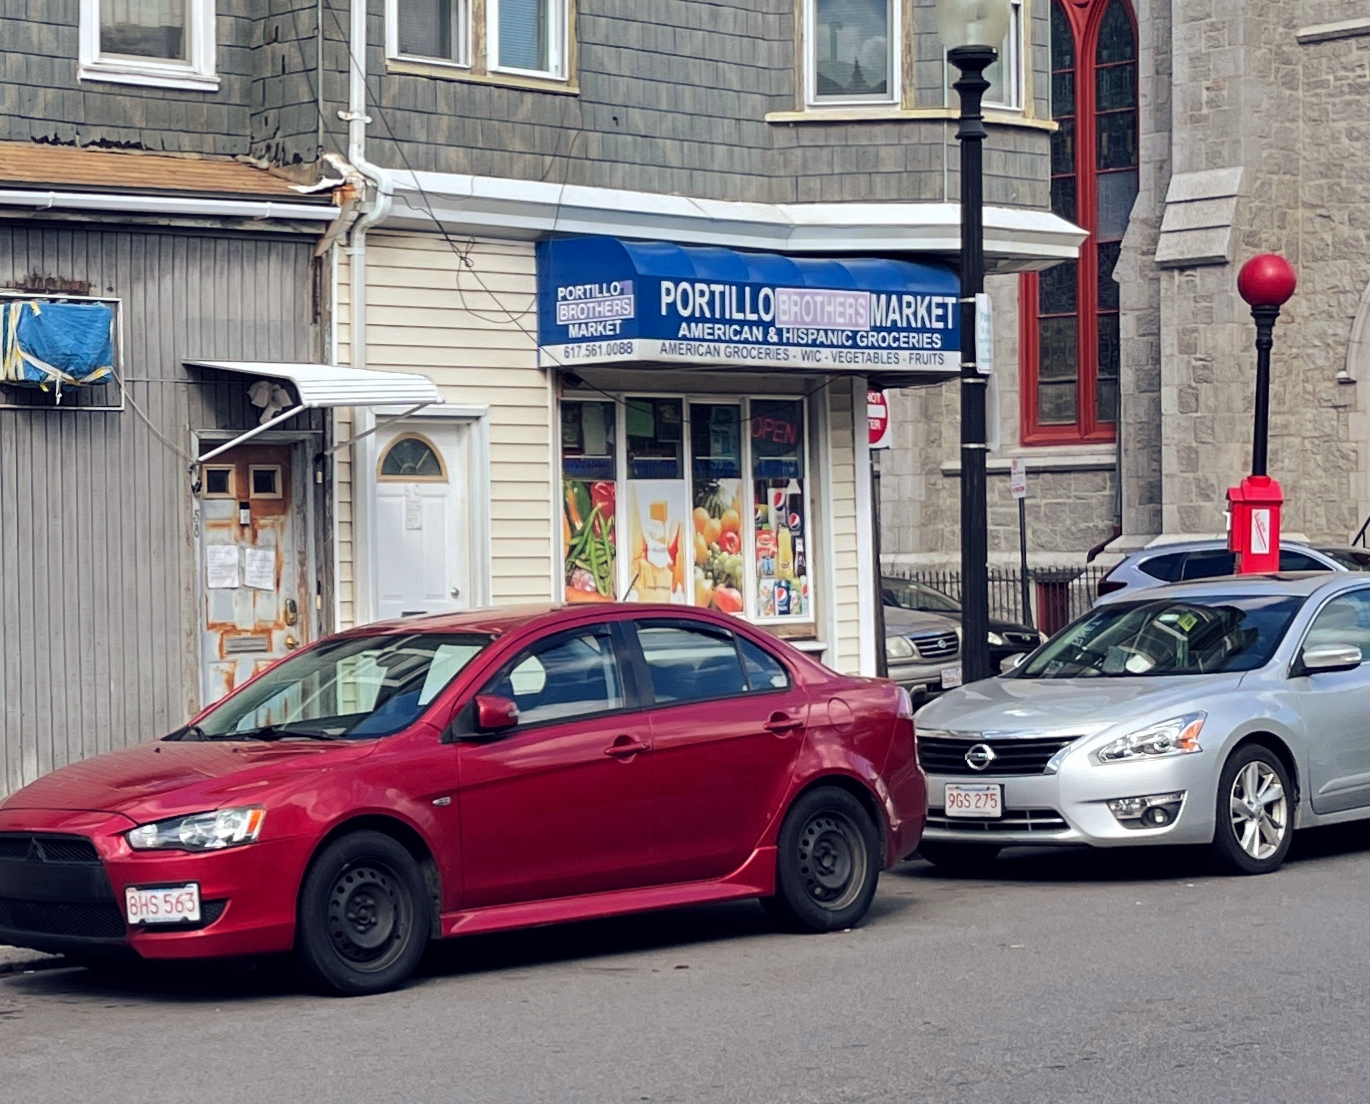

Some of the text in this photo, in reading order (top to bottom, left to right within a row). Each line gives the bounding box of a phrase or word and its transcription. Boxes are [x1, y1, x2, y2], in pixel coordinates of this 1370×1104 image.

[557, 281, 620, 301] PORTILLO
[559, 299, 630, 320] BROTHERS
[660, 280, 957, 330] PORTILLO BROTHERS MARKET
[568, 320, 622, 338] MARKET
[678, 321, 942, 348] AMERICAN & HISPANIC GROCERIES
[563, 341, 633, 359] 617.561.0088
[660, 341, 721, 357] AMERICAN
[724, 345, 790, 361] GROCERIES
[801, 349, 822, 362] WIC
[831, 350, 900, 364] VEGETABLES
[908, 352, 945, 365] FRUITS
[751, 416, 796, 445] OPEN
[949, 793, 997, 809] 9GS 275
[130, 892, 195, 916] 8HS 563
